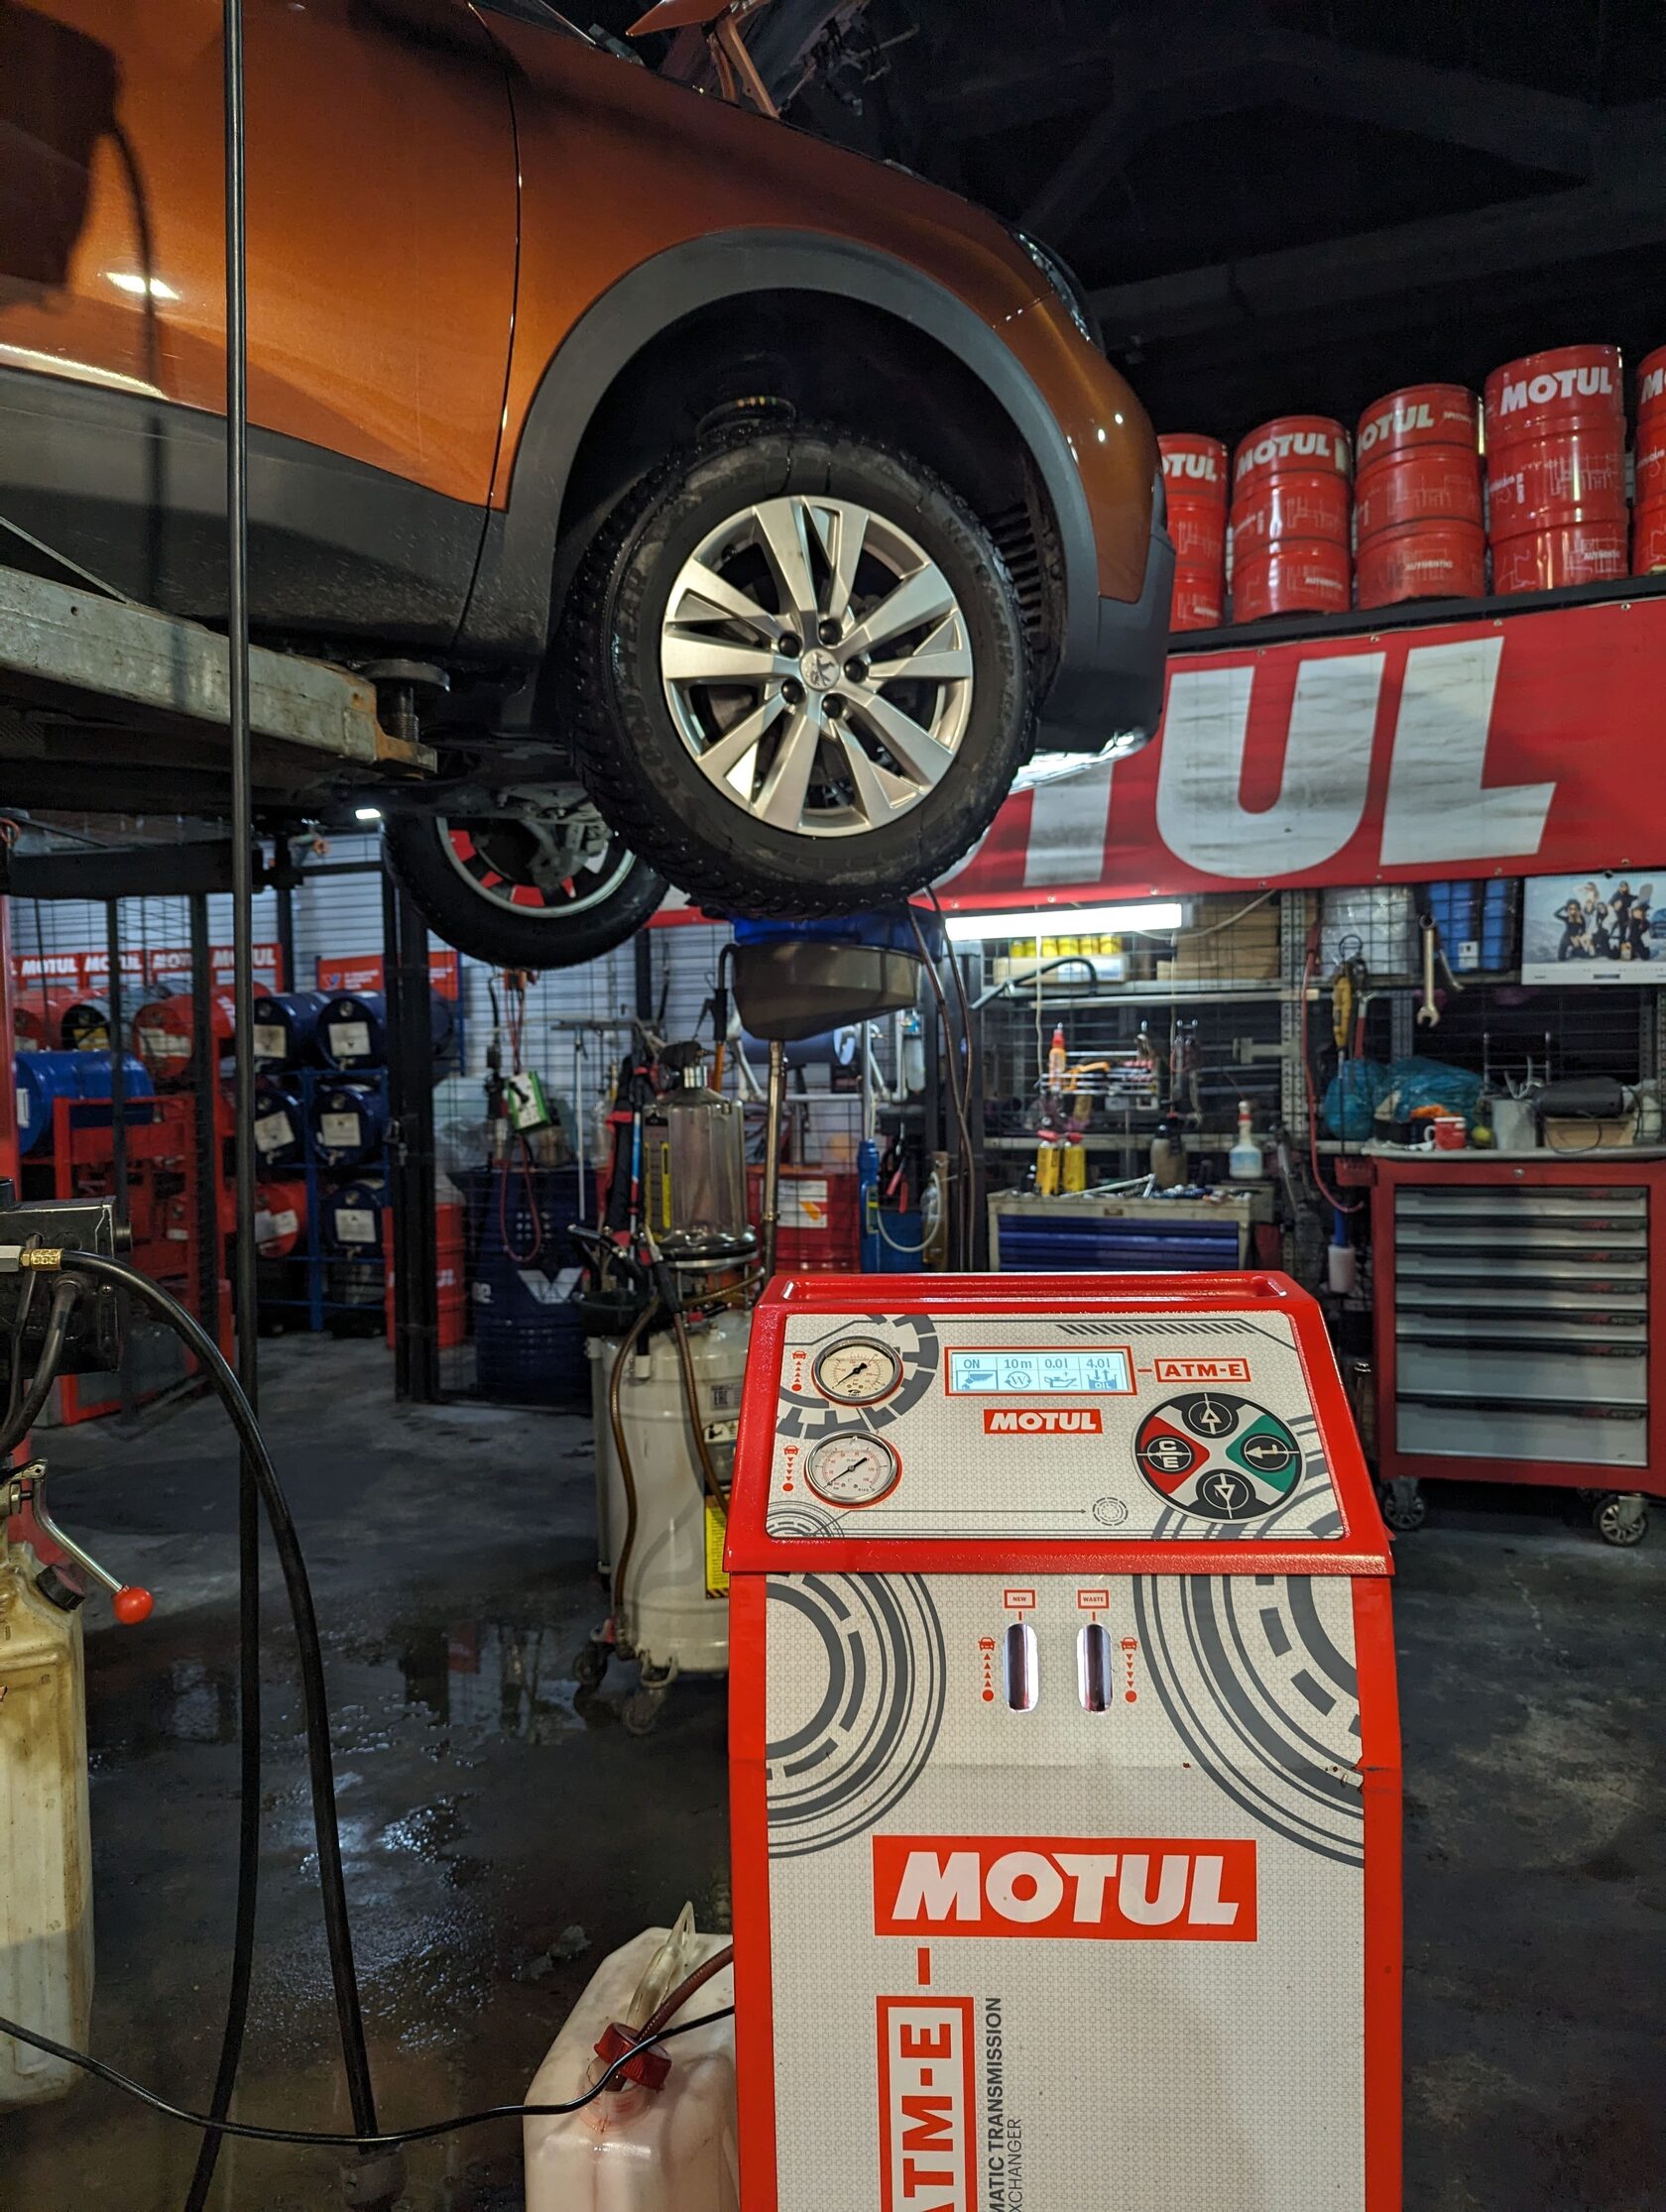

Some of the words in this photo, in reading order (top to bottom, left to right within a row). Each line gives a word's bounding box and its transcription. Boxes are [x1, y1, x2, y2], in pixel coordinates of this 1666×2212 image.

[1500, 367, 1612, 416] MOTUL
[1640, 367, 1666, 405] M
[1161, 452, 1218, 482] TUL
[21, 957, 78, 977] MOTUL
[84, 954, 143, 973] MOUL
[963, 1358, 981, 1369] ON
[1164, 1363, 1243, 1377] ATM-E
[990, 1412, 1097, 1431] MOTUL
[891, 1850, 1241, 1926] MOTUL
[986, 1998, 1005, 2153] TRANSMISSION
[899, 2024, 955, 2212] TM-E
